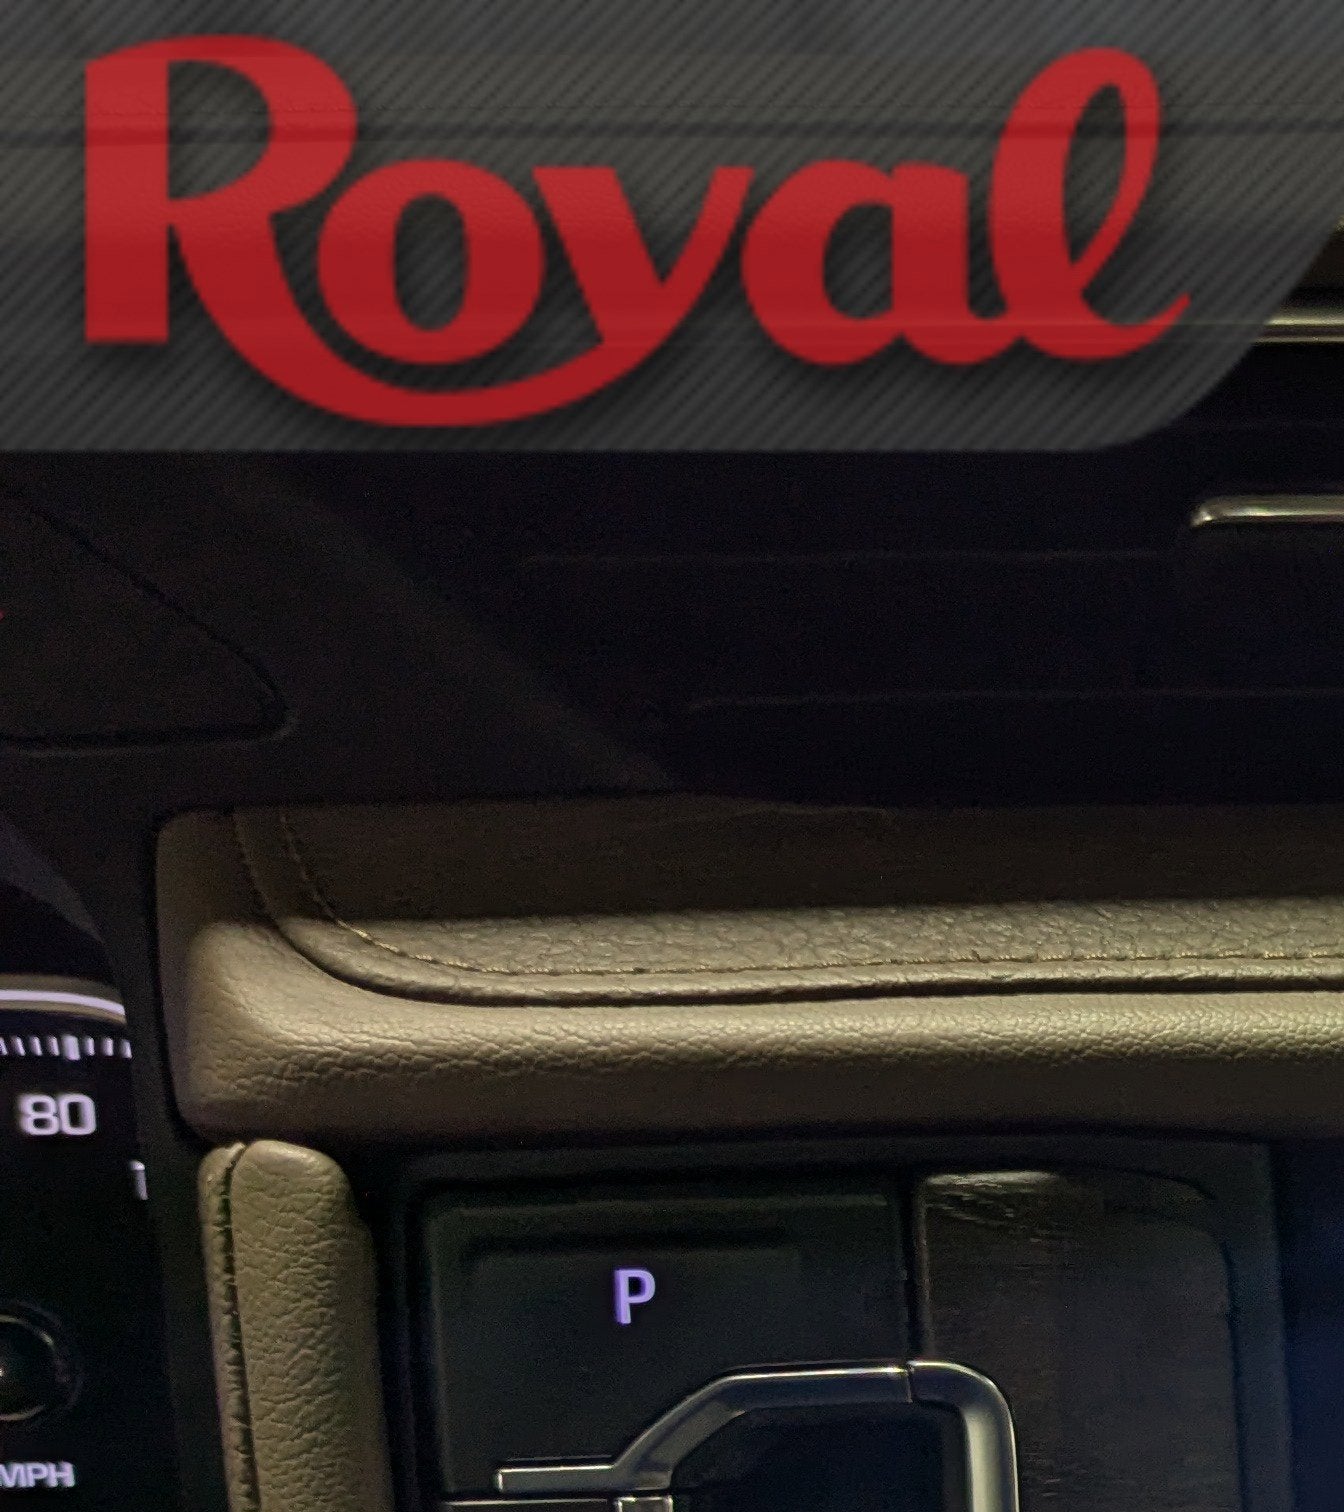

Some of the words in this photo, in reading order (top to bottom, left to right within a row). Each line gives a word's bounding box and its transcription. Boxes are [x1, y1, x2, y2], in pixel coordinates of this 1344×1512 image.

[19, 1092, 97, 1137] 80
[614, 1268, 656, 1325] P
[0, 1461, 76, 1488] MPH
